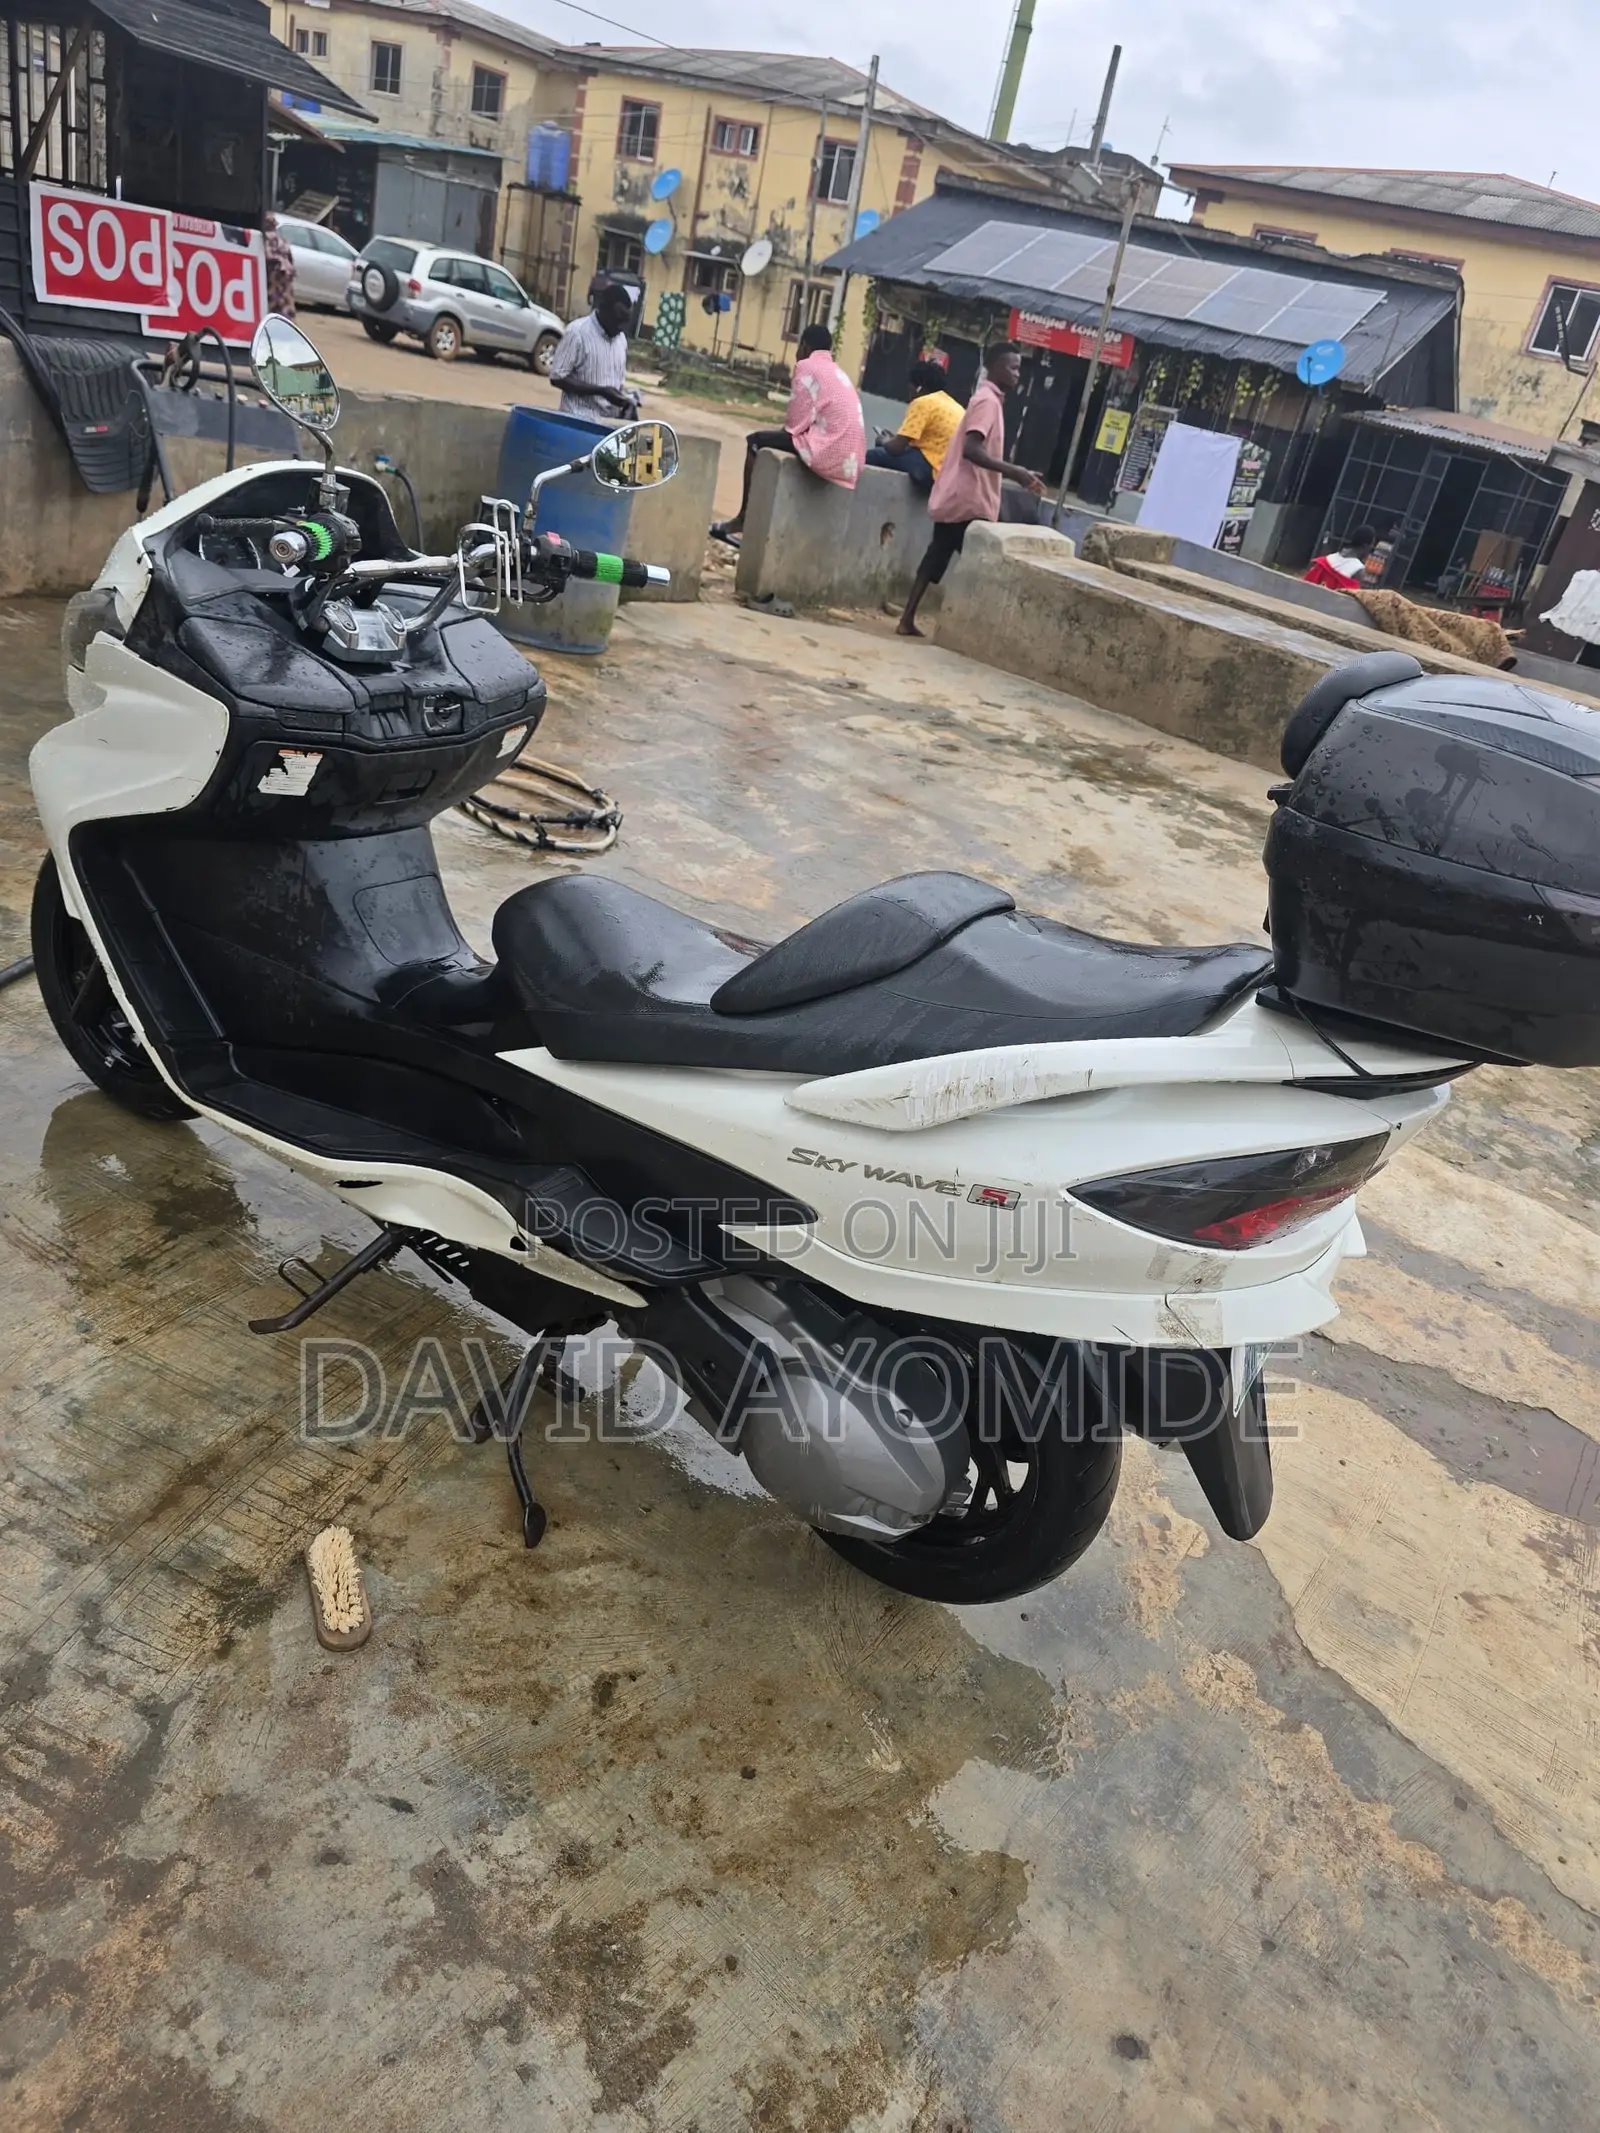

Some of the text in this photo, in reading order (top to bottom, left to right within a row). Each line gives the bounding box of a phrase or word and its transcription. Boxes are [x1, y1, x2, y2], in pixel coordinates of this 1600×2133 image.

[48, 203, 163, 287] POS
[787, 1146, 859, 1173] SKY
[863, 1164, 966, 1197] WAVE
